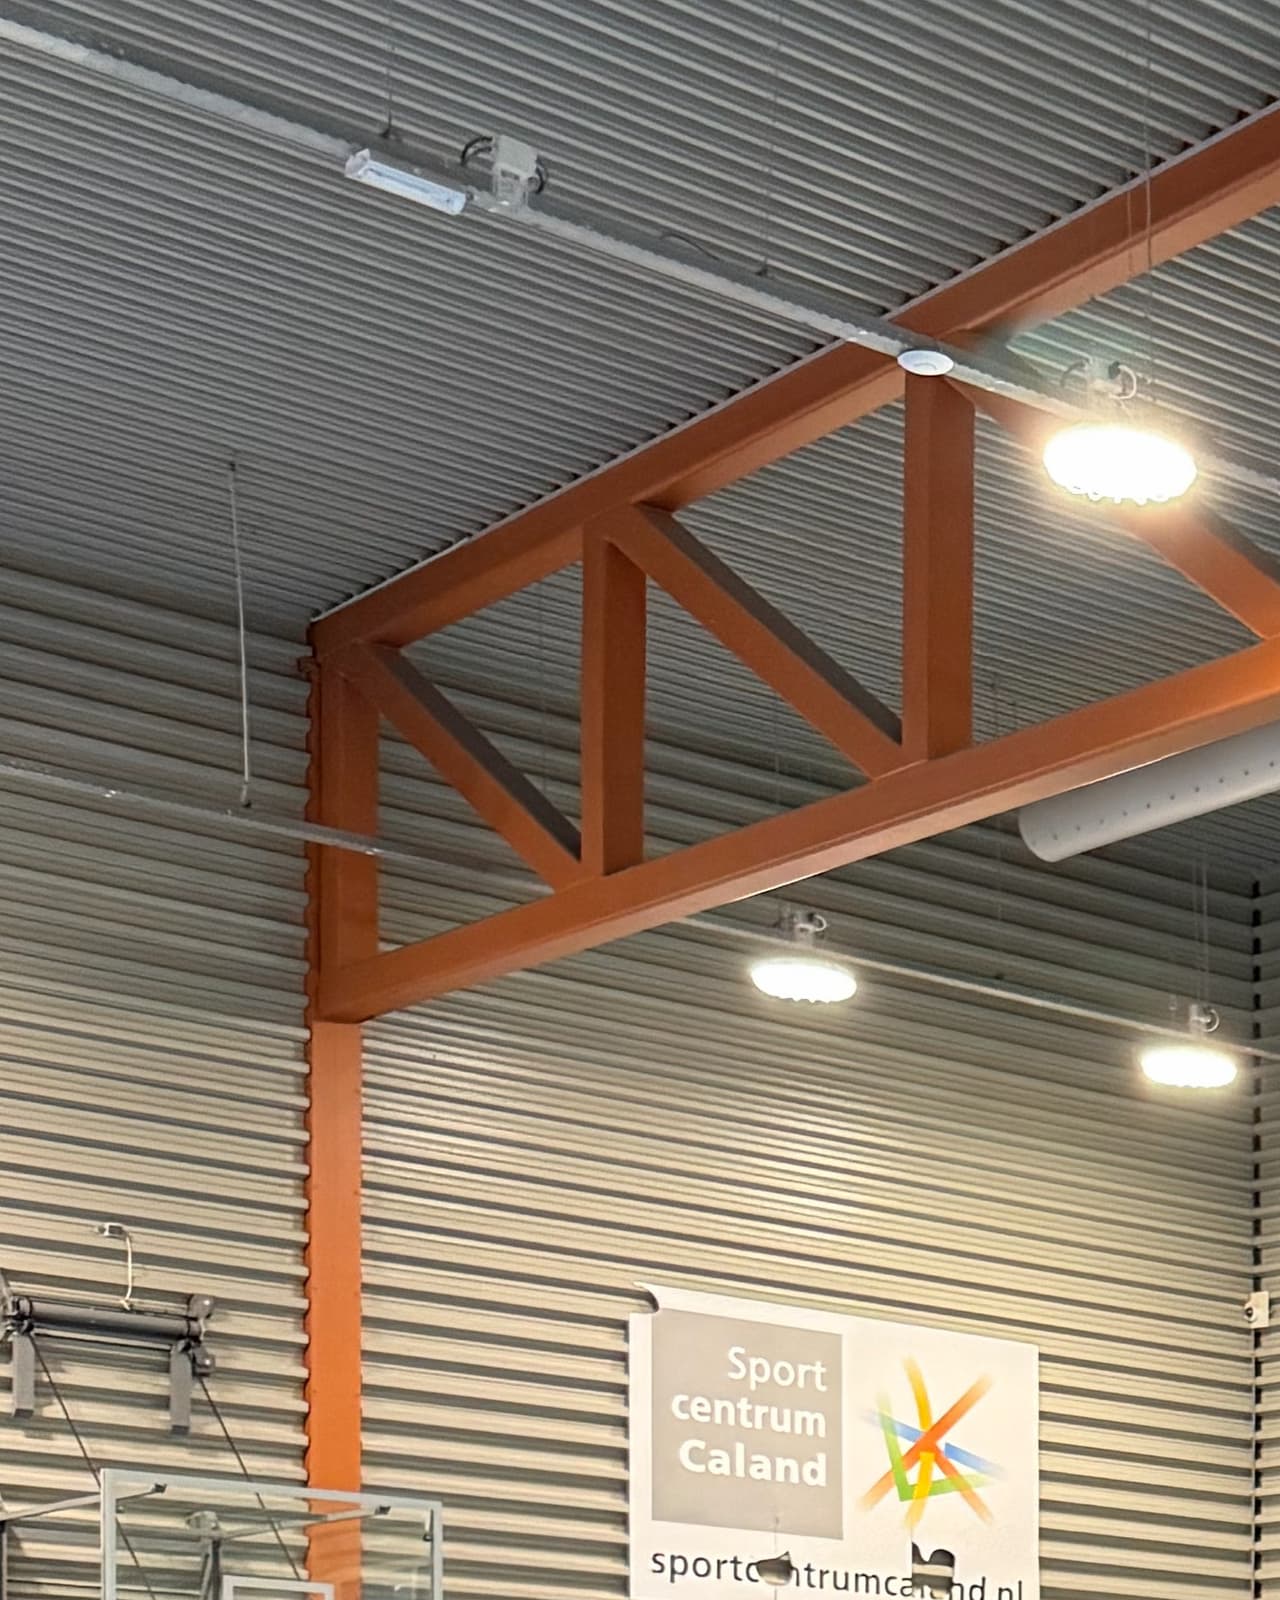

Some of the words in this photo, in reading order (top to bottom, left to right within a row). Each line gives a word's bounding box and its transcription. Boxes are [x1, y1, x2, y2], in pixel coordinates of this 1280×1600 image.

[727, 1345, 828, 1392] Sport
[671, 1392, 827, 1439] centrum
[678, 1439, 828, 1488] Caland
